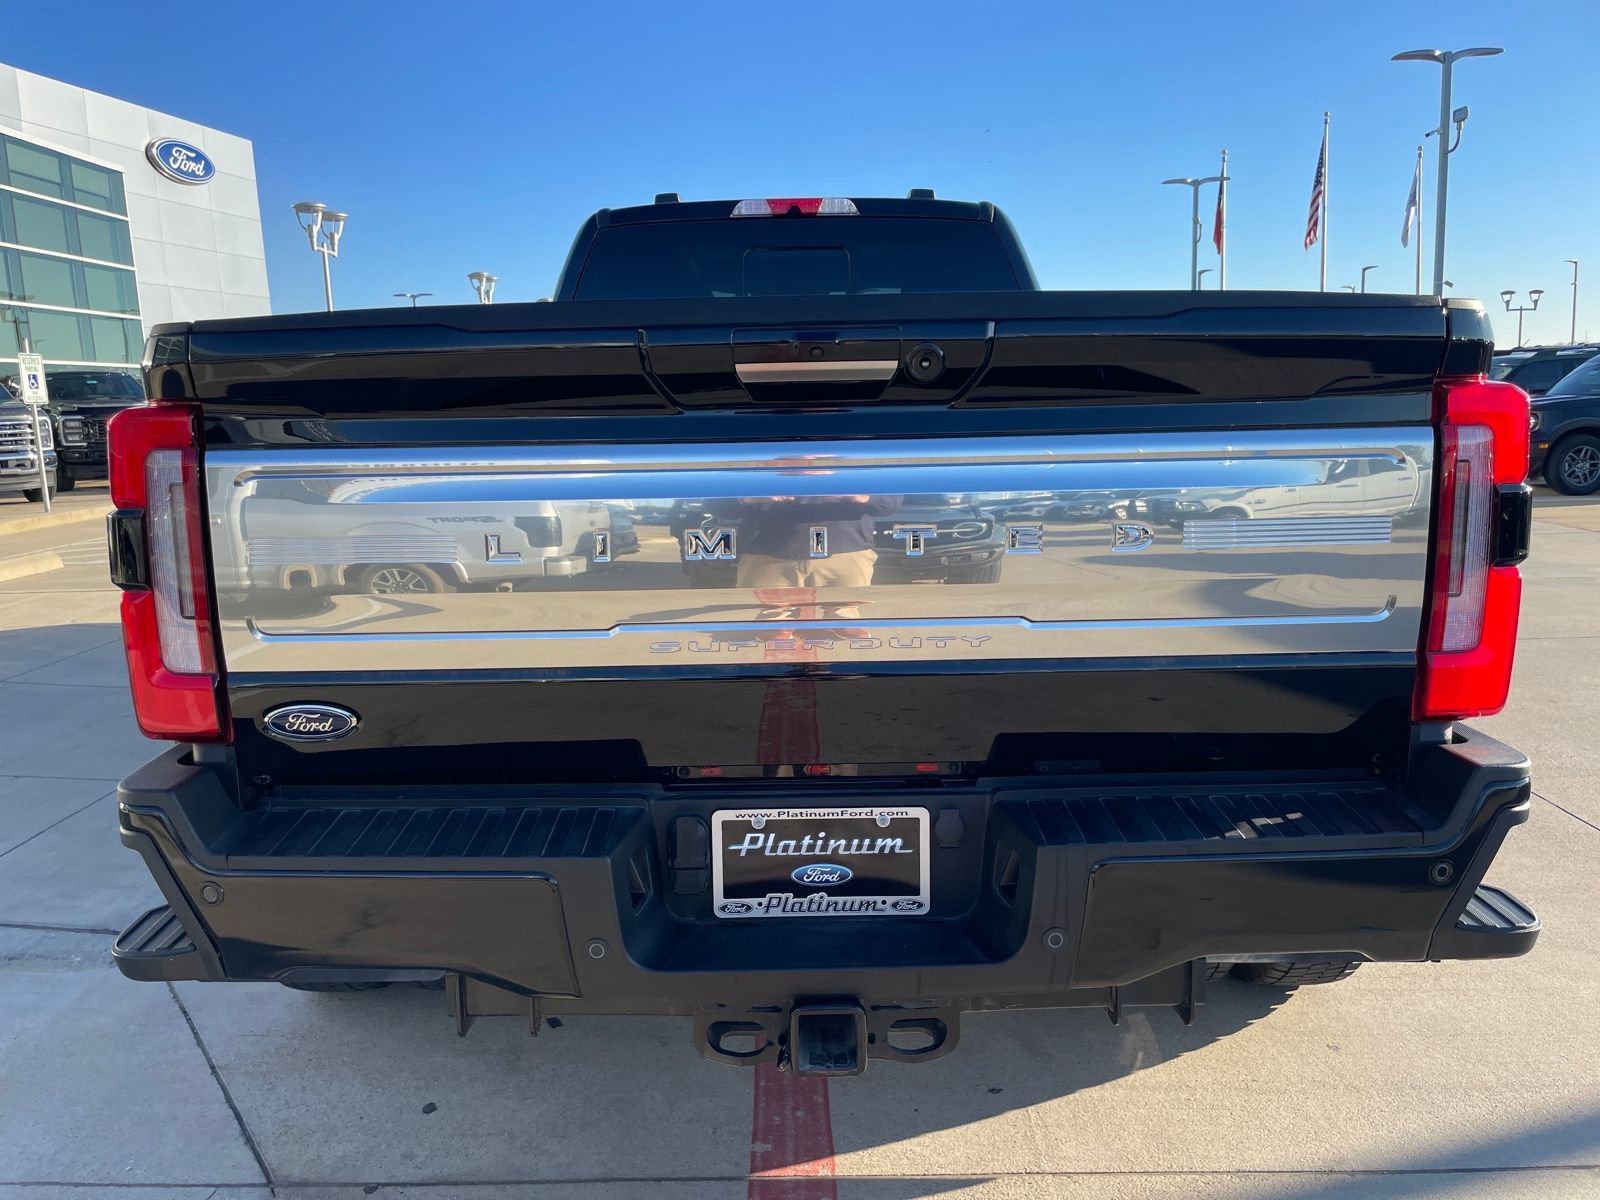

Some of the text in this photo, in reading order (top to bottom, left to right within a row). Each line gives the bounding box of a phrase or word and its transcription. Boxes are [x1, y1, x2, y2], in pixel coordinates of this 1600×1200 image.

[169, 147, 205, 176] Ford
[484, 520, 1156, 564] LIMITED
[285, 712, 334, 732] Ford
[735, 809, 909, 819] www.PlatinumFord.com
[728, 831, 914, 857] Platinum
[803, 867, 841, 883] Ford
[725, 896, 919, 914] Ford Platinum Ford
